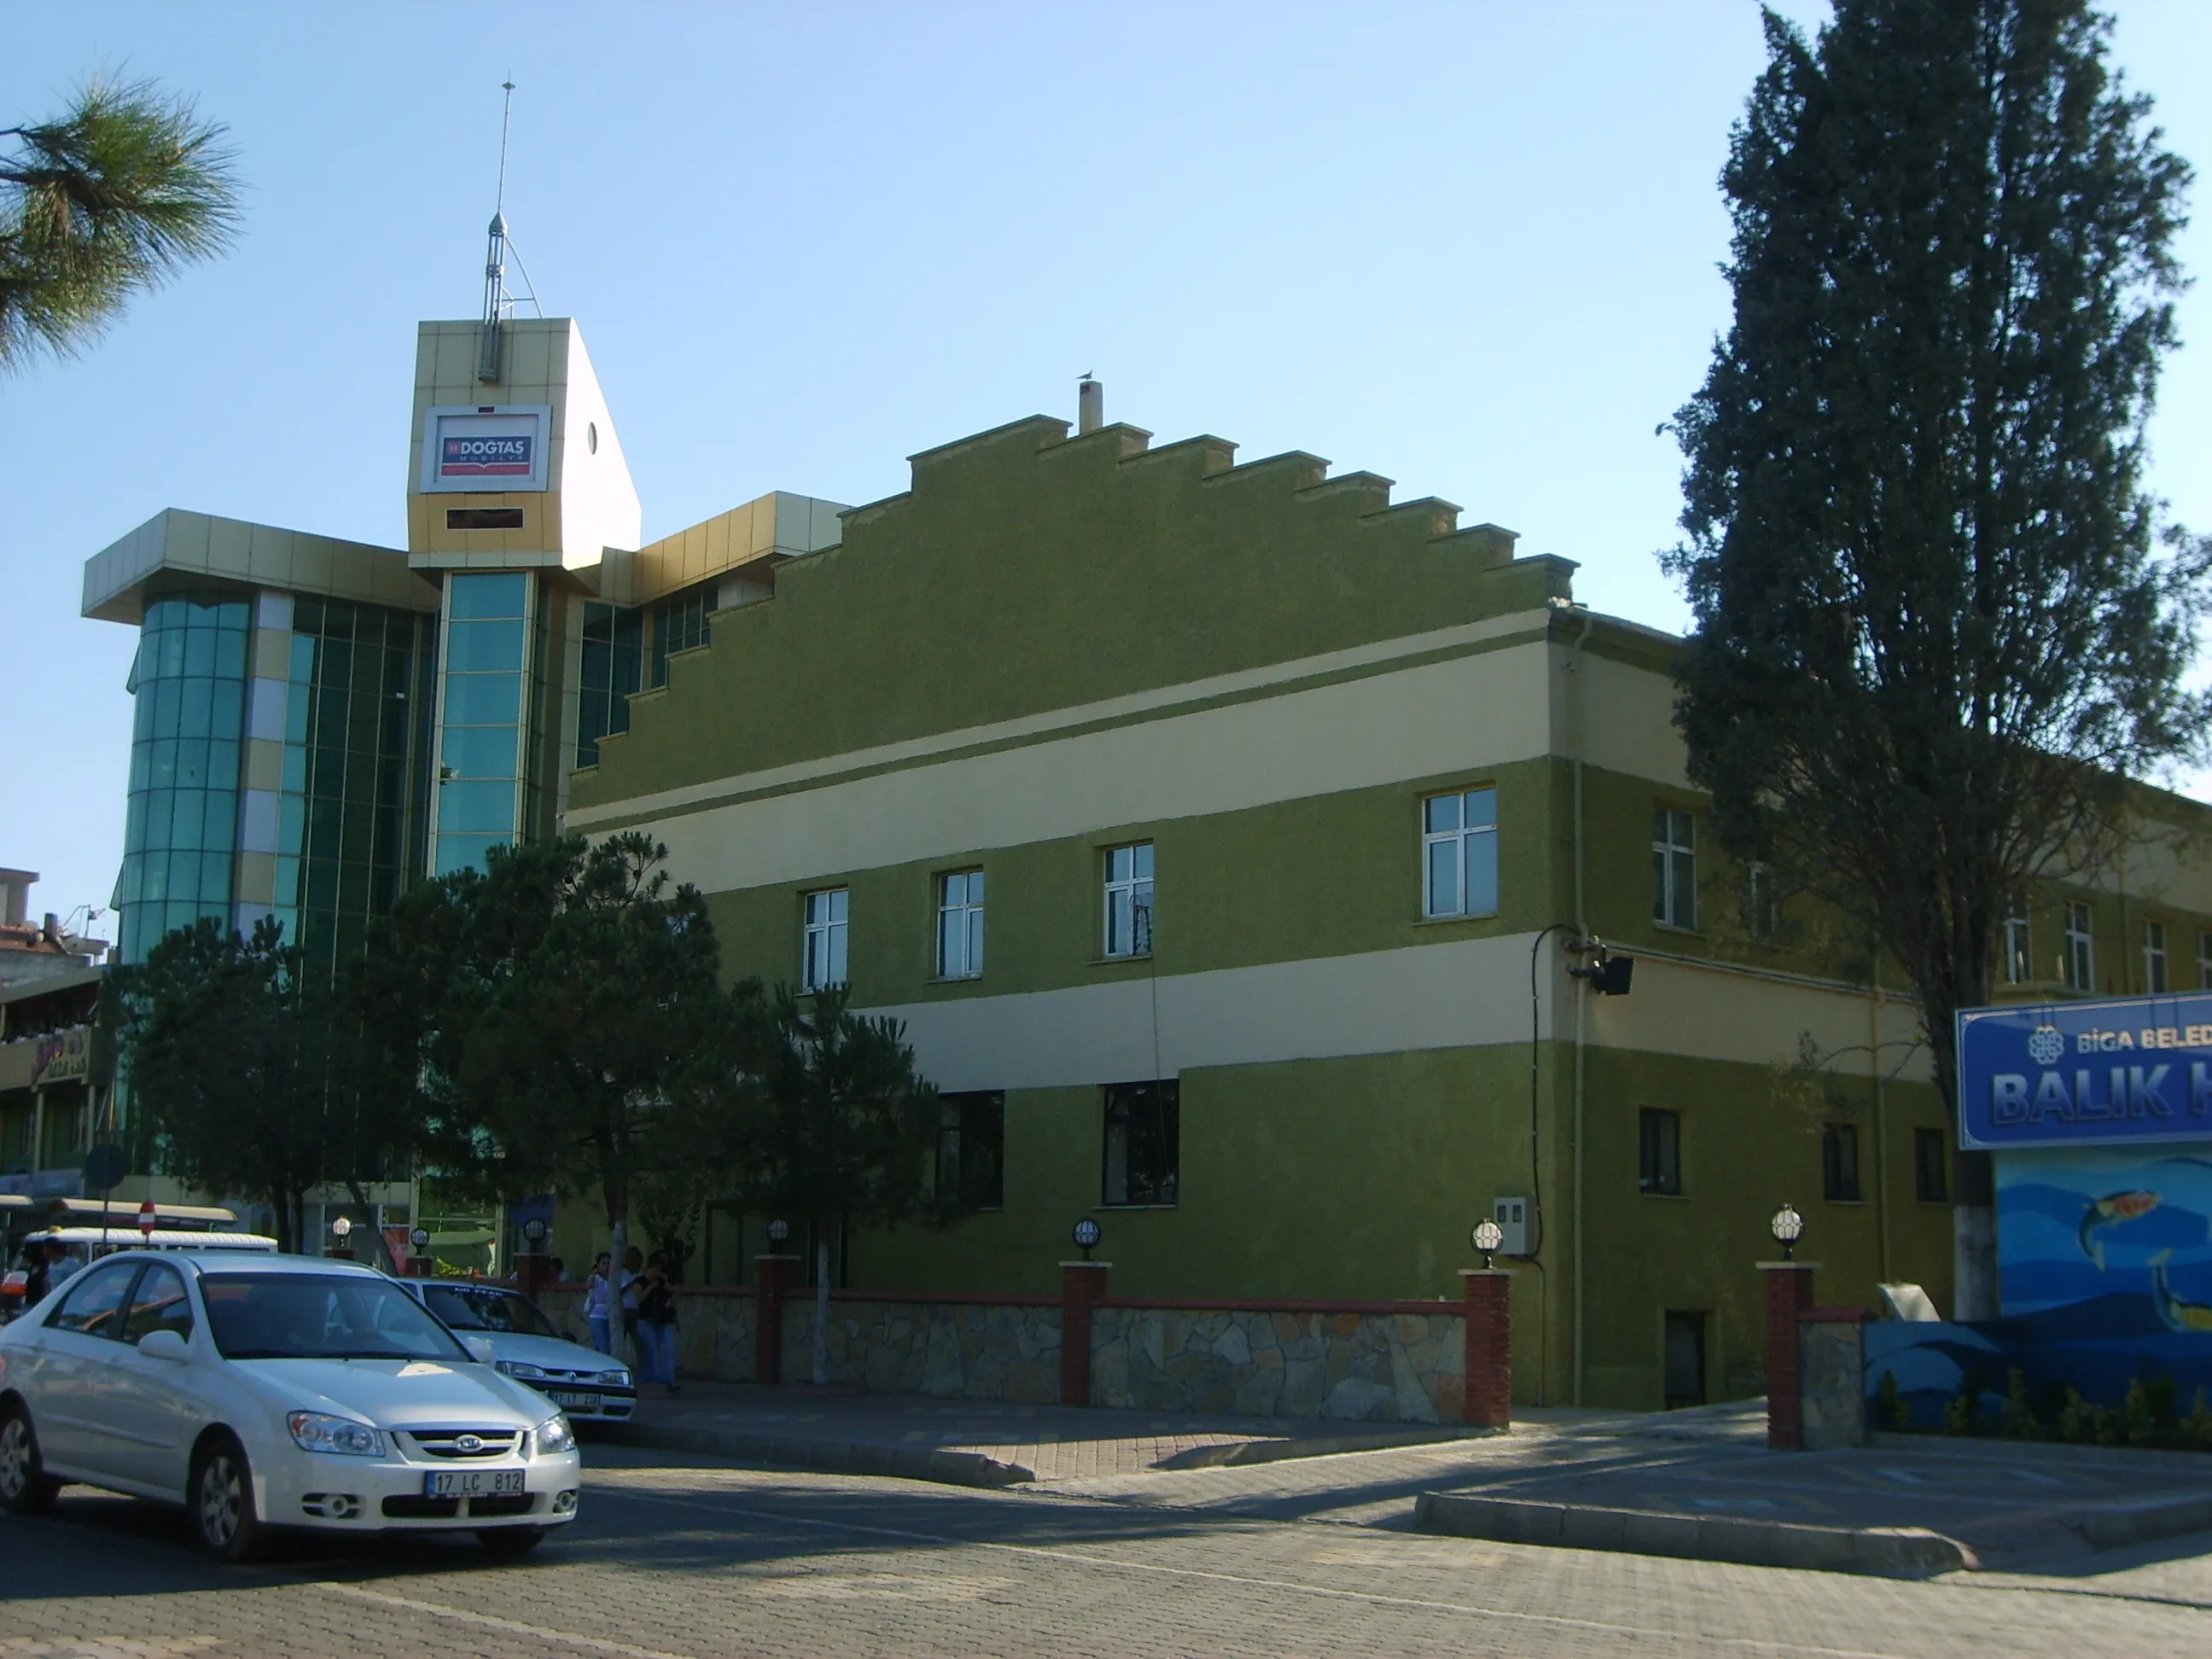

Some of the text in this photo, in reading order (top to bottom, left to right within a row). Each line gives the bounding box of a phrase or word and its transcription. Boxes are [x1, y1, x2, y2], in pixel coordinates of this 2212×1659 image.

[1992, 1063, 2174, 1125] BALIK
[436, 1473, 521, 1493] 17 LC 812
